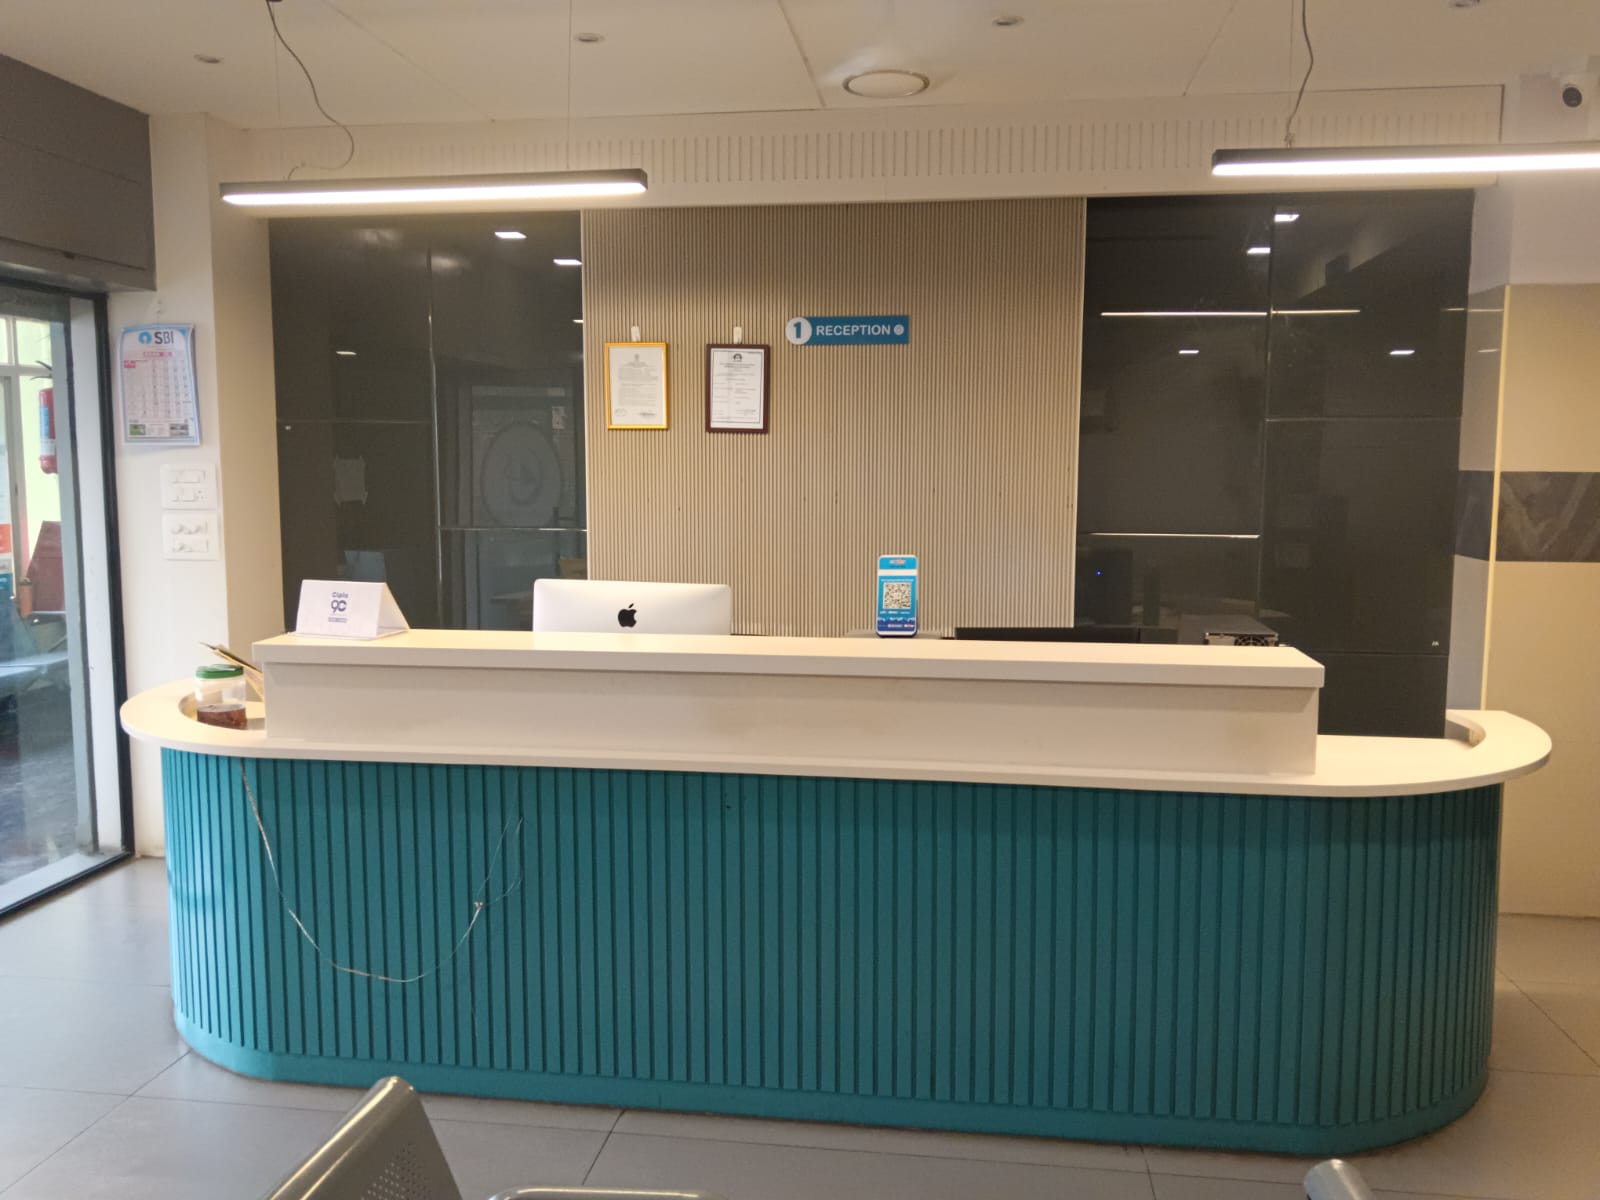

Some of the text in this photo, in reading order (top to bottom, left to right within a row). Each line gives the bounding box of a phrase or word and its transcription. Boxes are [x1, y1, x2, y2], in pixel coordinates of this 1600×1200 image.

[154, 330, 175, 344] SBI
[793, 321, 891, 339] 1 RECEPTION
